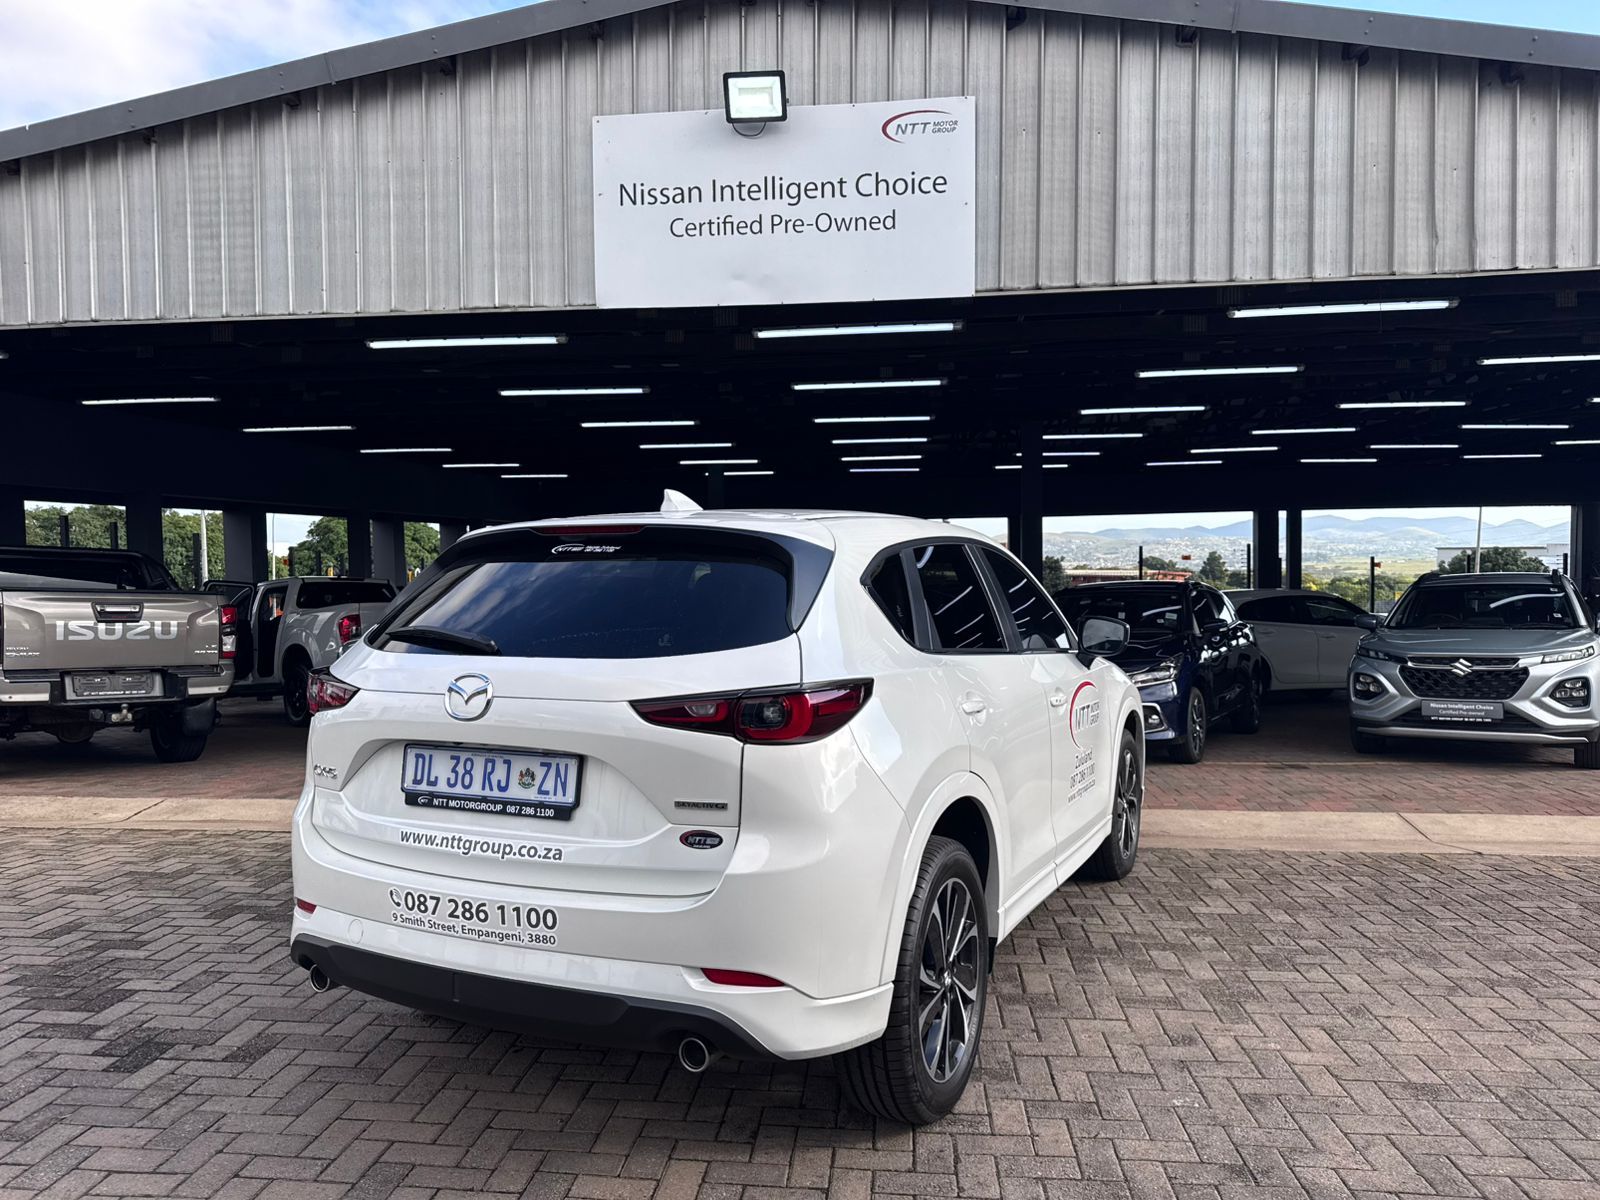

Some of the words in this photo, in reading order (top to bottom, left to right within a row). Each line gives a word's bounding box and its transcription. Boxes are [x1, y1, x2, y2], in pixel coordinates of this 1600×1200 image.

[895, 122, 931, 135] NTT
[618, 182, 702, 206] Nissan
[711, 175, 847, 206] Intelligent
[854, 171, 948, 197] Choice
[669, 214, 763, 238] Certified
[769, 209, 897, 235] Pre-Owned
[55, 620, 178, 641] ISUZU
[1075, 704, 1090, 731] NTT
[411, 752, 439, 787] DL
[446, 755, 475, 790] 38
[481, 758, 512, 793] RJ
[536, 761, 569, 797] ZN
[432, 797, 447, 807] NTT
[448, 799, 503, 813] MOTORGROUP
[506, 805, 520, 814] 087
[521, 806, 535, 815] 286
[536, 807, 555, 817] 1100
[400, 829, 563, 861] www.nttgroup.co.za
[404, 891, 441, 916] 087
[447, 898, 489, 923] 286
[496, 904, 558, 930] 1100
[392, 912, 399, 922] 9
[400, 914, 426, 928] Smith
[427, 918, 459, 935] Street,
[461, 925, 525, 943] Empangeni,
[527, 933, 556, 945] 3880
